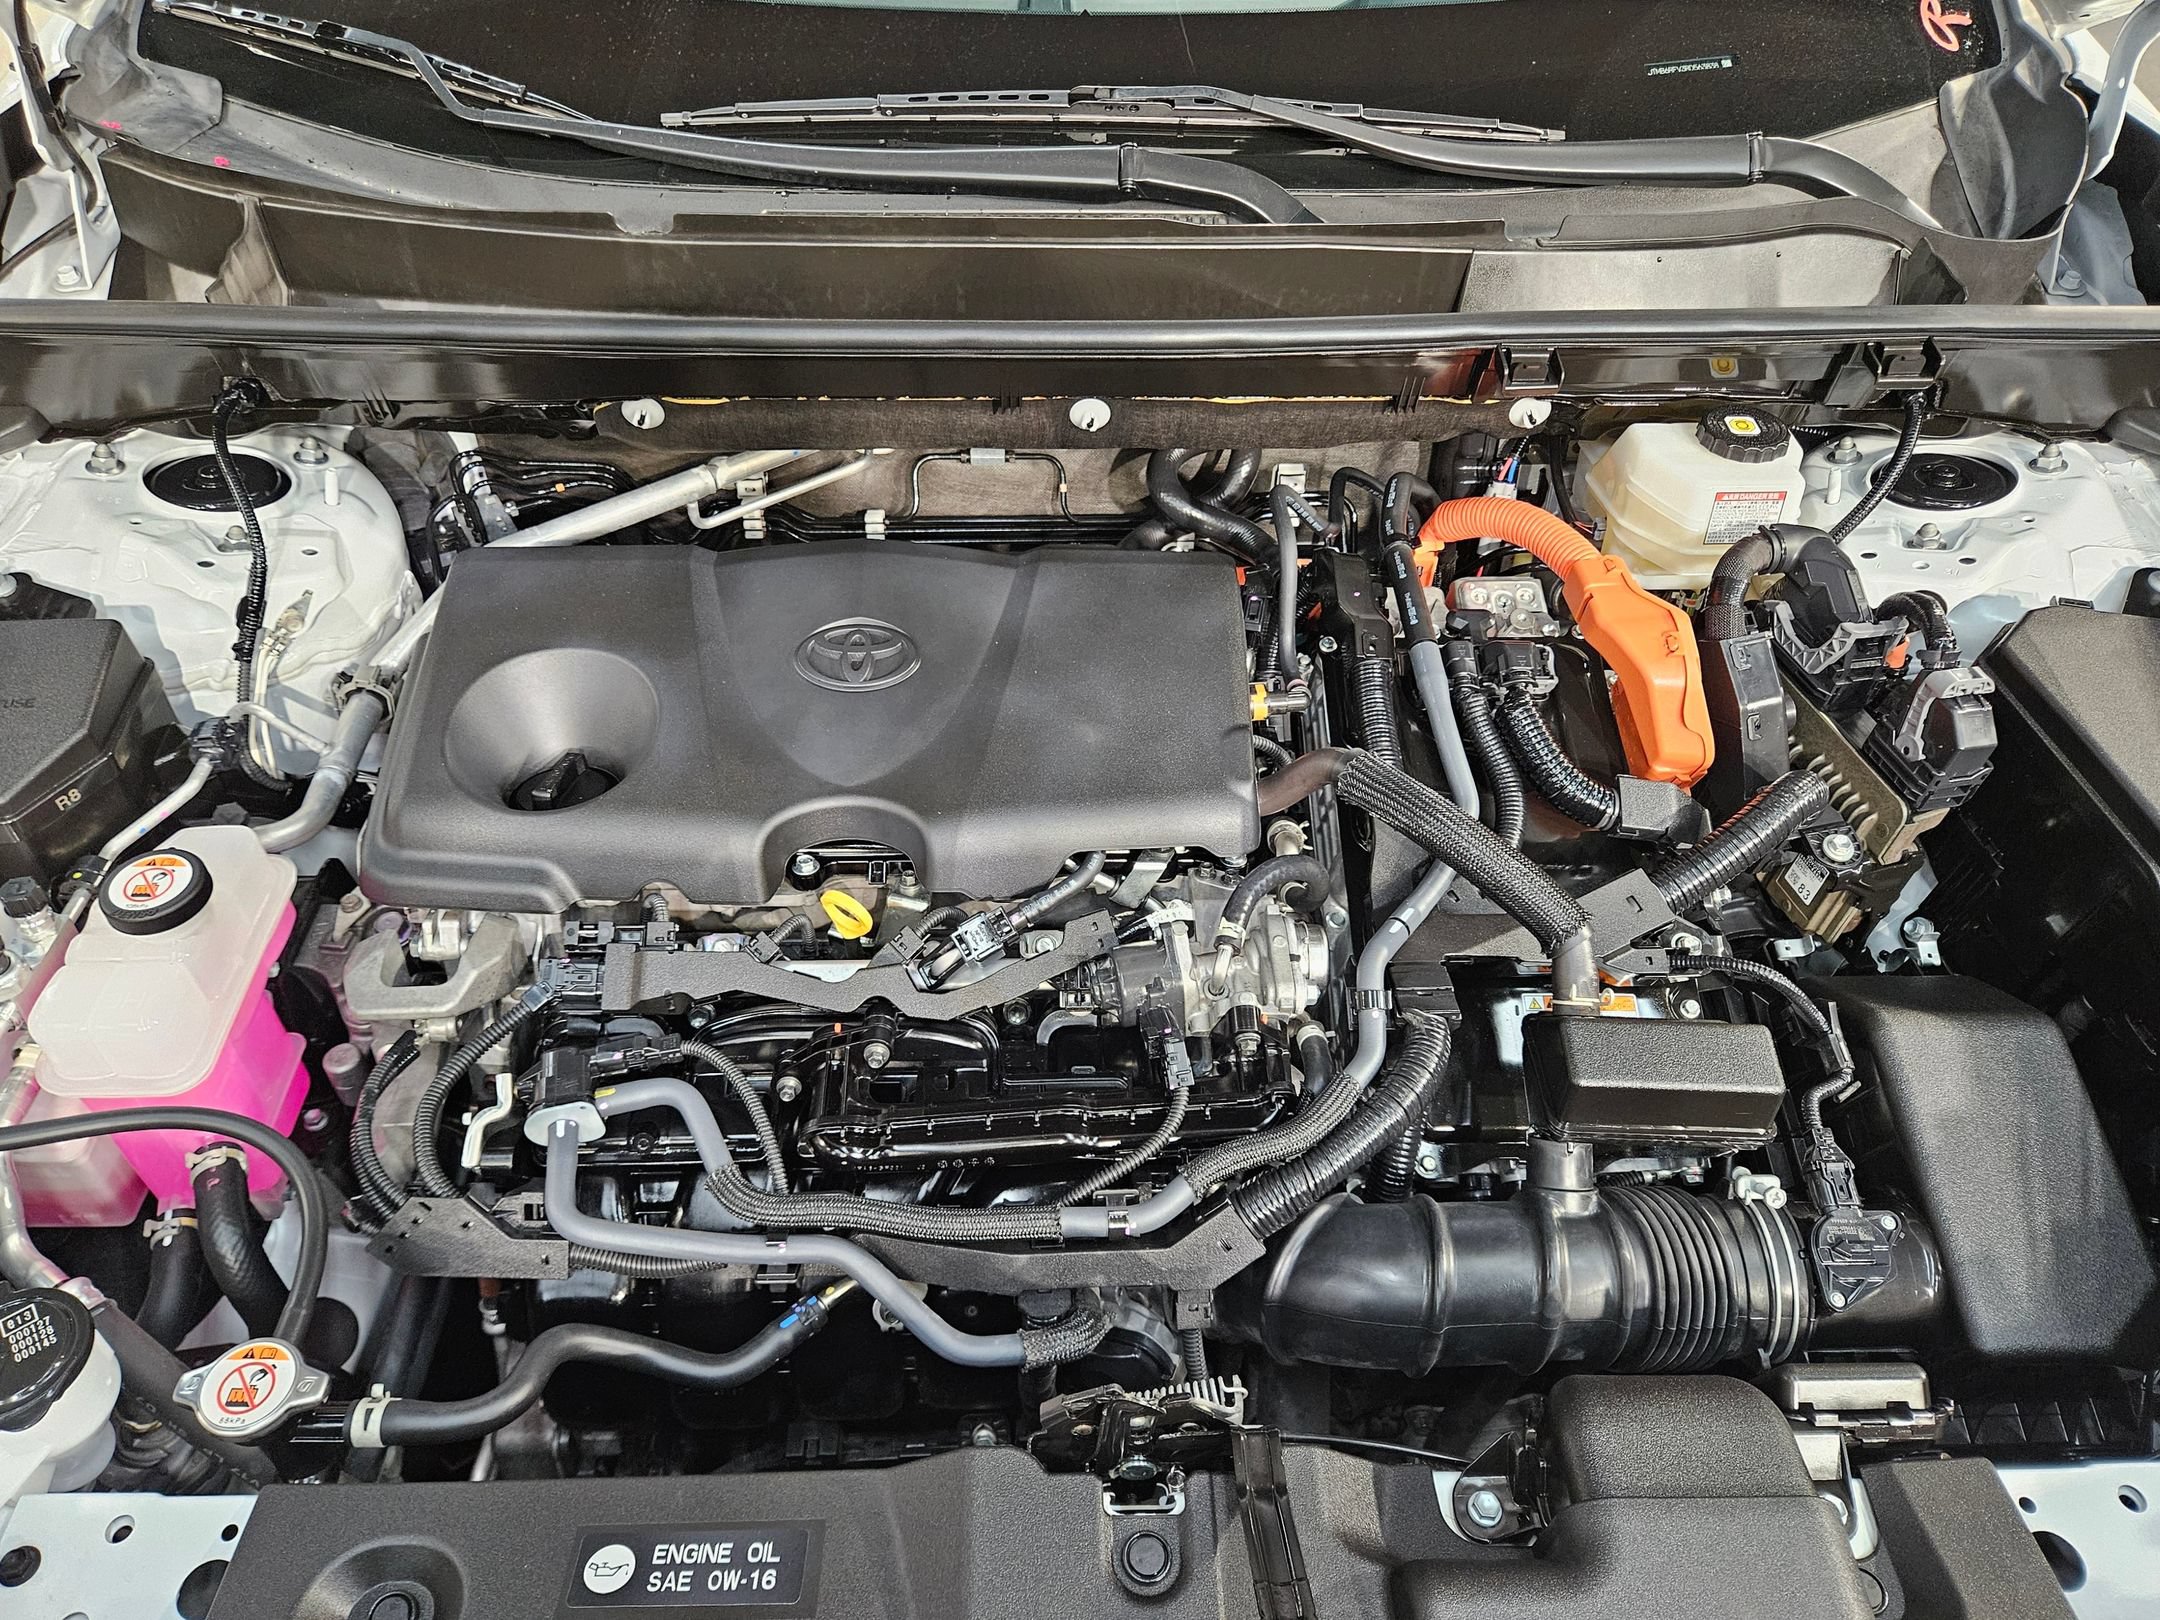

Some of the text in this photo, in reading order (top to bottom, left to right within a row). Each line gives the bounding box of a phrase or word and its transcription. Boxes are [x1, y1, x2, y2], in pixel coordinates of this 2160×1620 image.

[54, 788, 82, 811] R8
[1797, 883, 1811, 900] 83
[7, 1311, 32, 1329] e13
[9, 1315, 50, 1344] 000127
[11, 1325, 54, 1353] 000128
[14, 1334, 57, 1362] 000145
[652, 1541, 780, 1565] ENGINE OIL
[646, 1568, 777, 1592] SAE 0W-16
